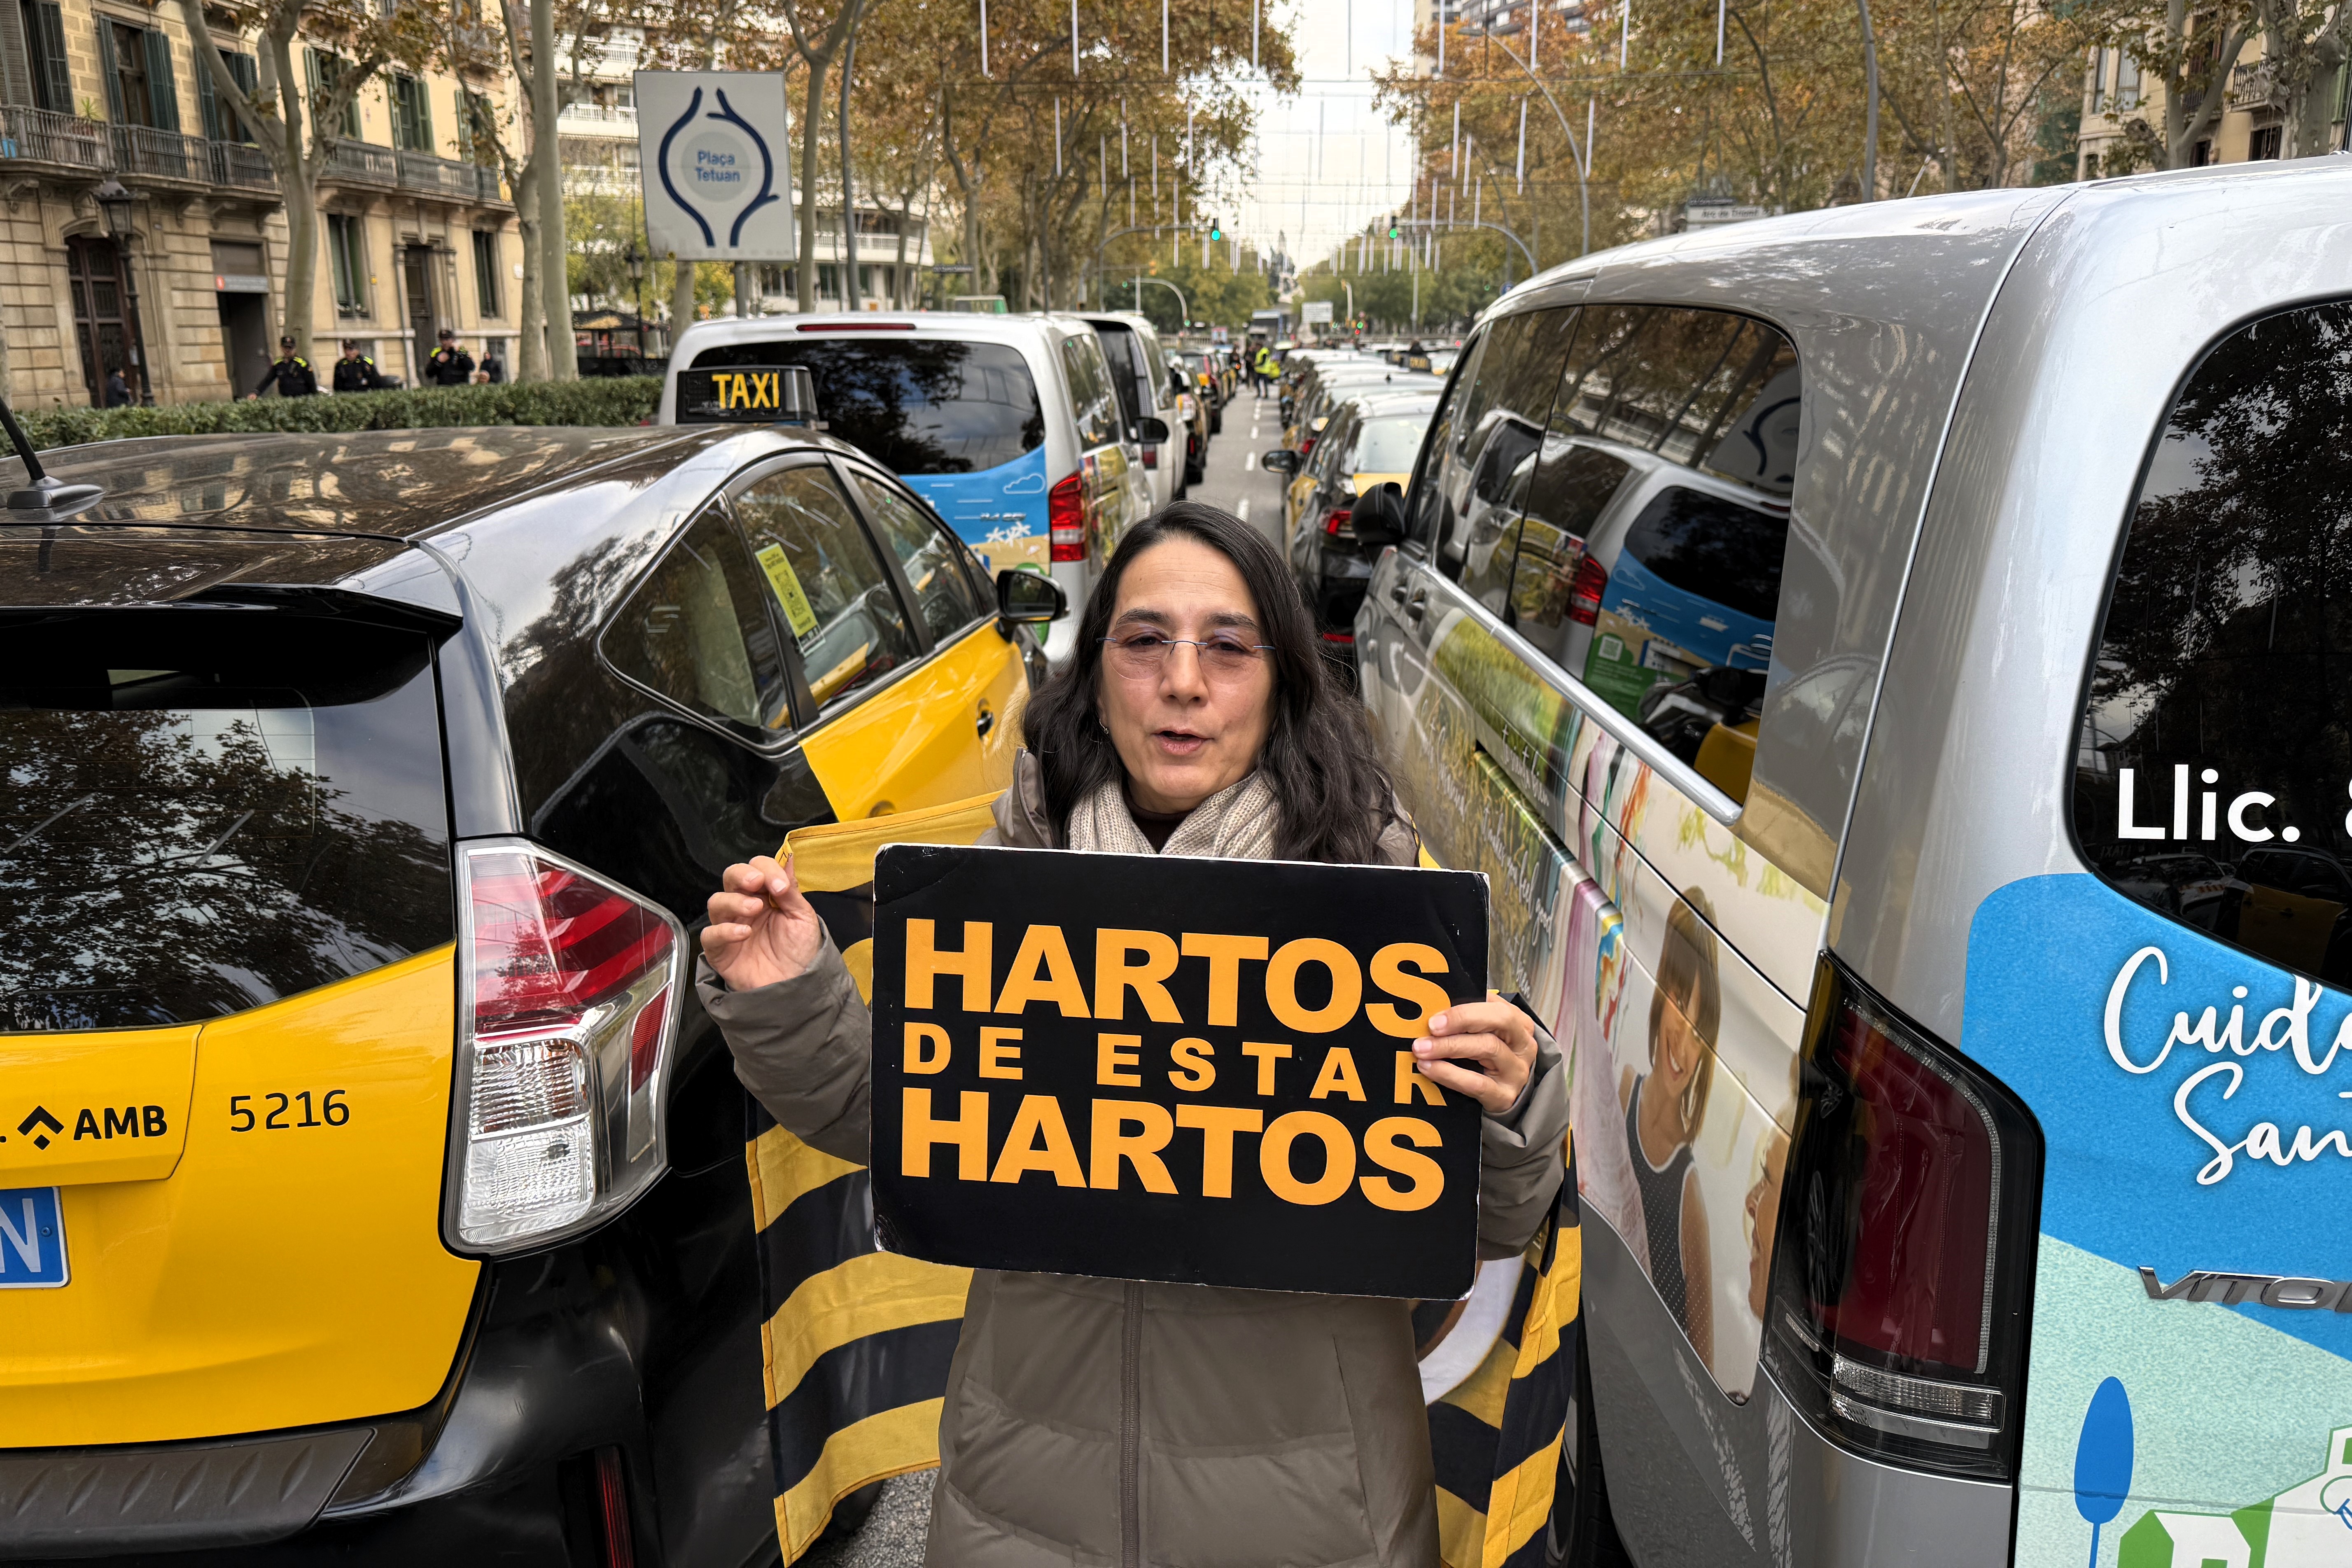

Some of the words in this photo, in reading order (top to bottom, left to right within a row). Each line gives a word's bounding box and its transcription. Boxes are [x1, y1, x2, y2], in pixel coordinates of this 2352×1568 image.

[695, 166, 740, 182] Tetuan
[698, 149, 735, 167] Plaça
[712, 373, 779, 409] TAXI
[2118, 764, 2301, 842] Llic.
[1518, 850, 1539, 920] feel
[1531, 890, 1559, 949] good
[904, 918, 1451, 1038] HARTOS
[2104, 946, 2352, 1074] Cuid
[903, 1022, 1023, 1080] DE
[1096, 1034, 1447, 1106] ESTAR
[74, 1105, 168, 1140] AMB
[231, 1090, 350, 1132] 5216
[901, 1088, 1444, 1211] HARTOS
[2174, 1061, 2352, 1185] San
